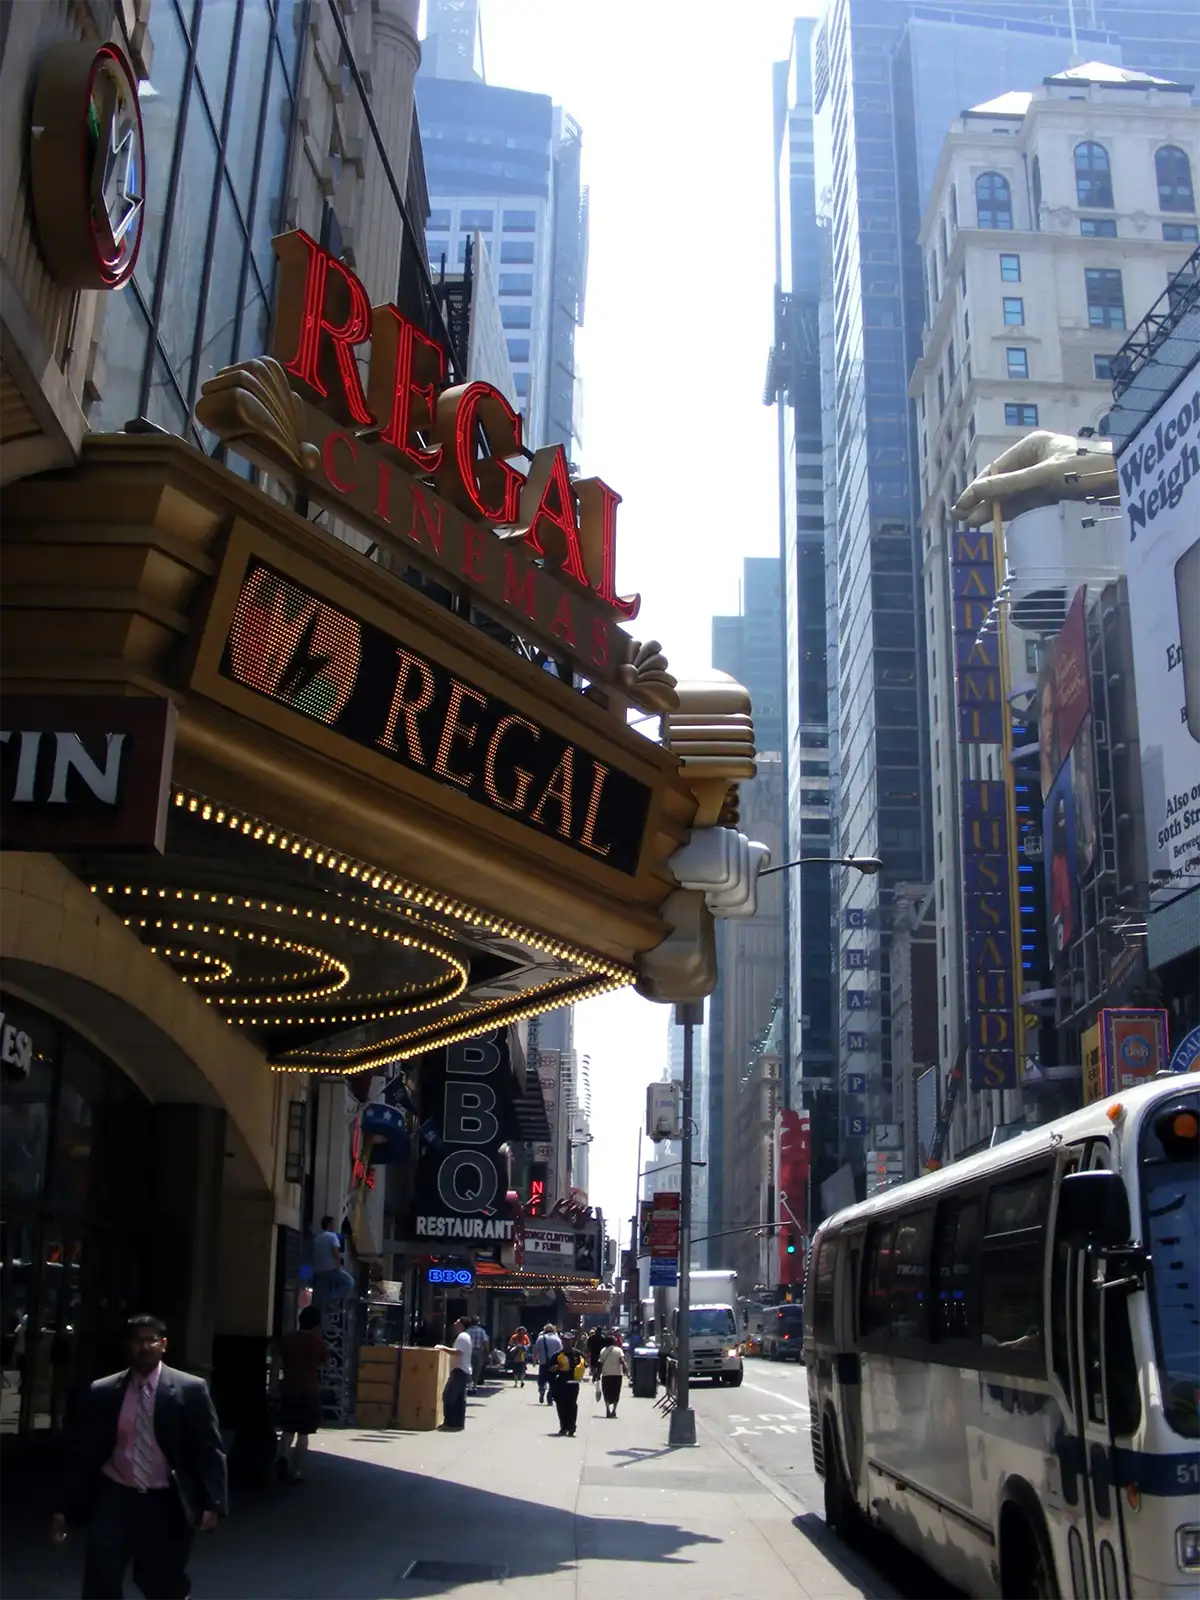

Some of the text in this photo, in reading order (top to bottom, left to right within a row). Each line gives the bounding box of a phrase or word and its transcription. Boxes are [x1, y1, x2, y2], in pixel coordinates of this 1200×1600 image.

[287, 228, 641, 621] REGAL
[1127, 431, 1200, 542] Neigh
[323, 431, 610, 667] CINEMAS
[0, 731, 126, 805] IN
[375, 647, 611, 856] REGAL
[1157, 818, 1182, 849] 50th
[1166, 793, 1189, 819] Also
[849, 912, 863, 1133] CHAMPS
[437, 1030, 500, 1217] BBQ
[416, 1216, 514, 1239] RESTAURANT
[428, 1269, 472, 1285] BBQ
[1177, 1464, 1199, 1483] 51
